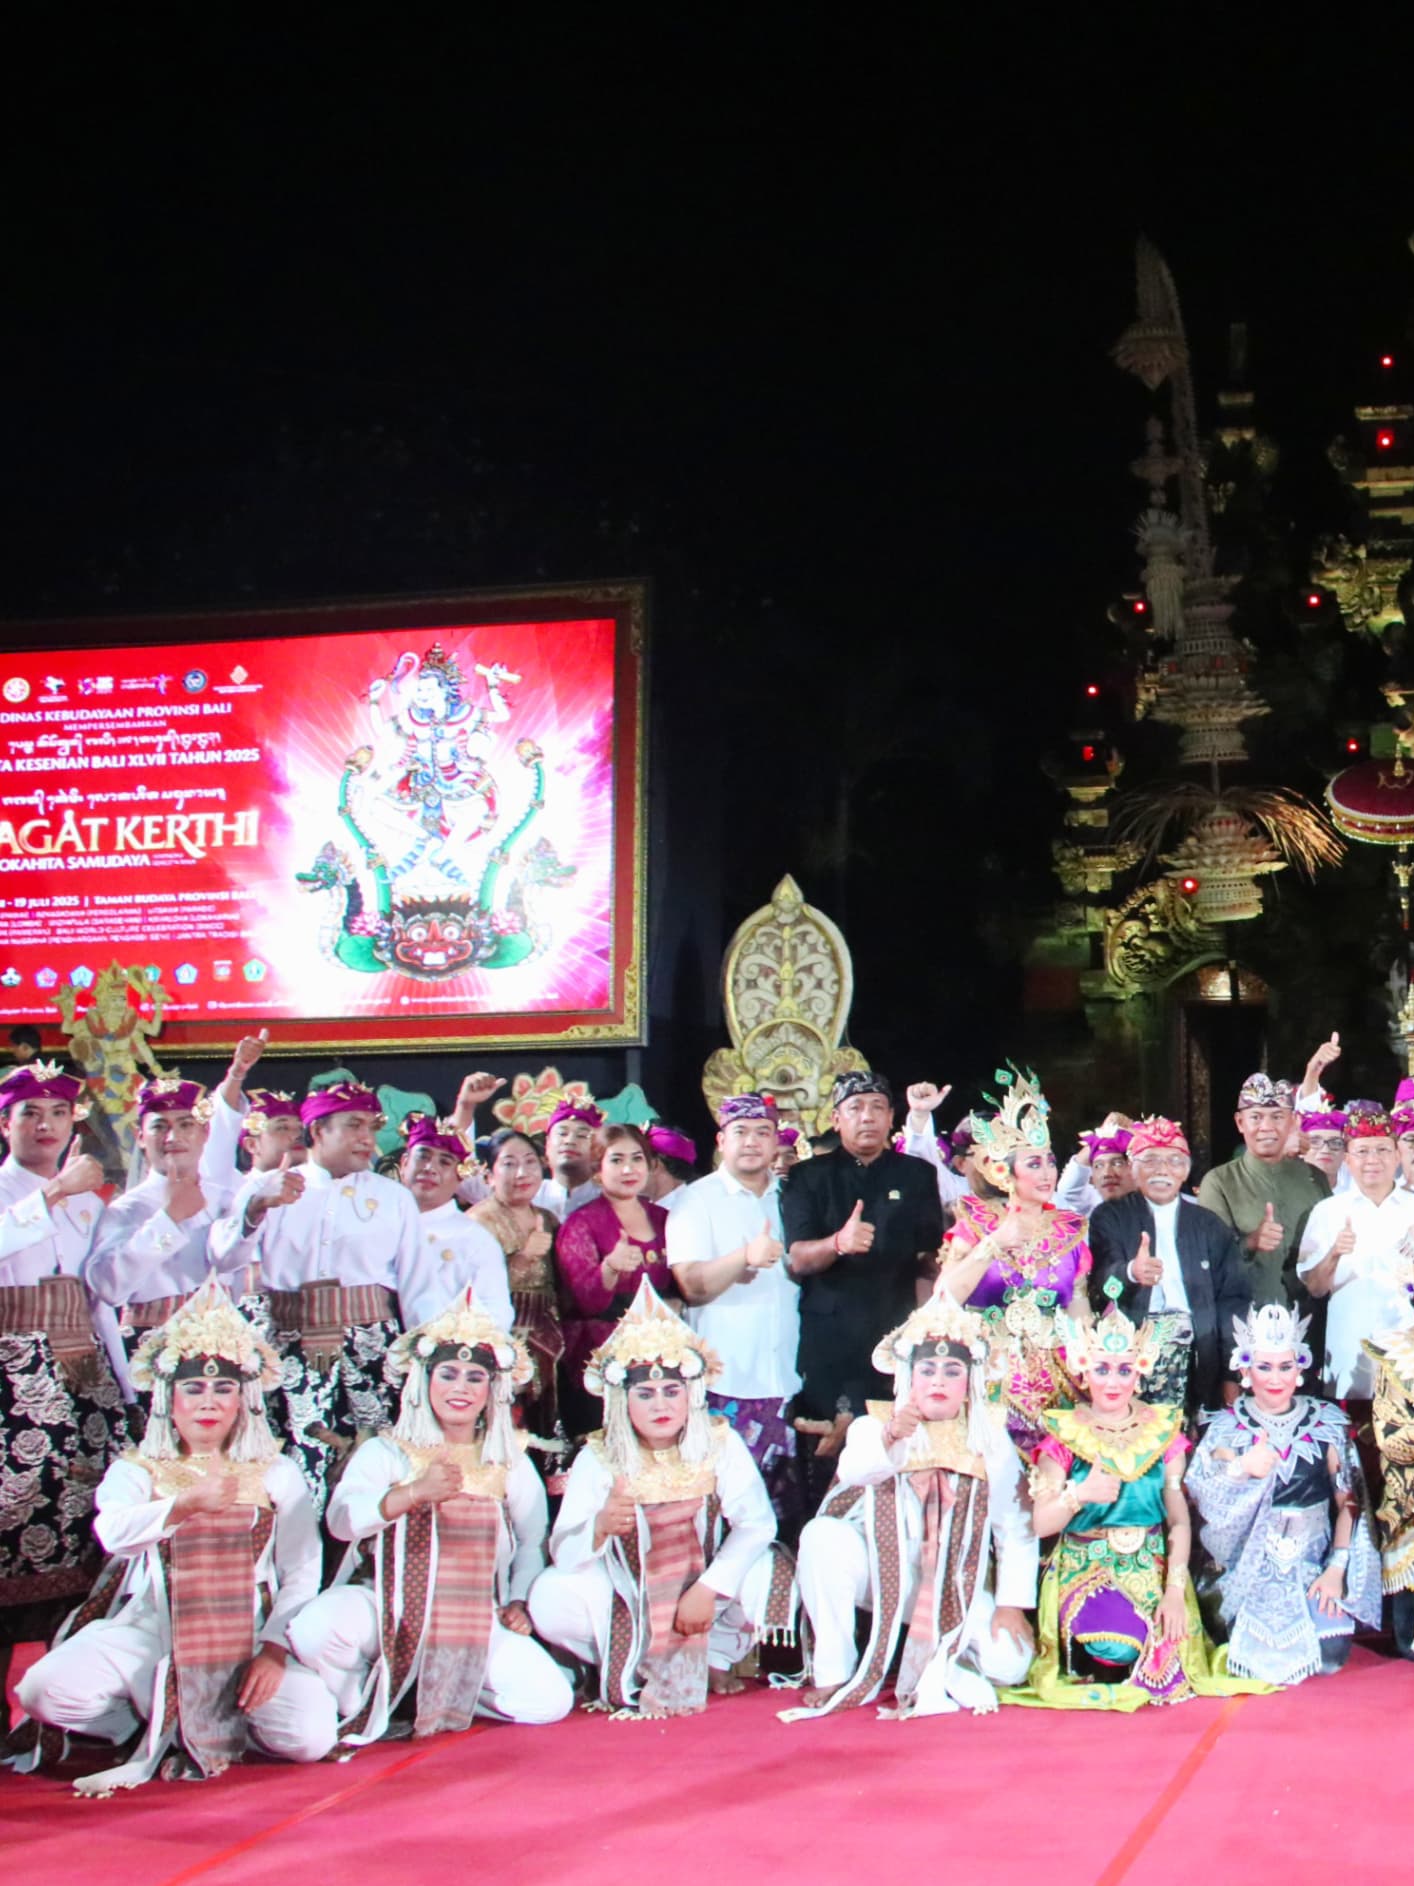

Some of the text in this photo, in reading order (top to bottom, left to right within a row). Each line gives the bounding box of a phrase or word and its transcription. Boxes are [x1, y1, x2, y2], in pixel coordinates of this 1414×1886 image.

[0, 702, 232, 723] DINAS KEBUDAYAAN PROVINSI BALI
[15, 756, 89, 772] KESENIAN
[91, 754, 126, 769] BALI
[128, 752, 167, 768] XLVII
[169, 750, 222, 765] TAHUN
[223, 747, 261, 763] 2025
[115, 810, 260, 858] KERTHI
[67, 853, 151, 869] SAMUDAYA
